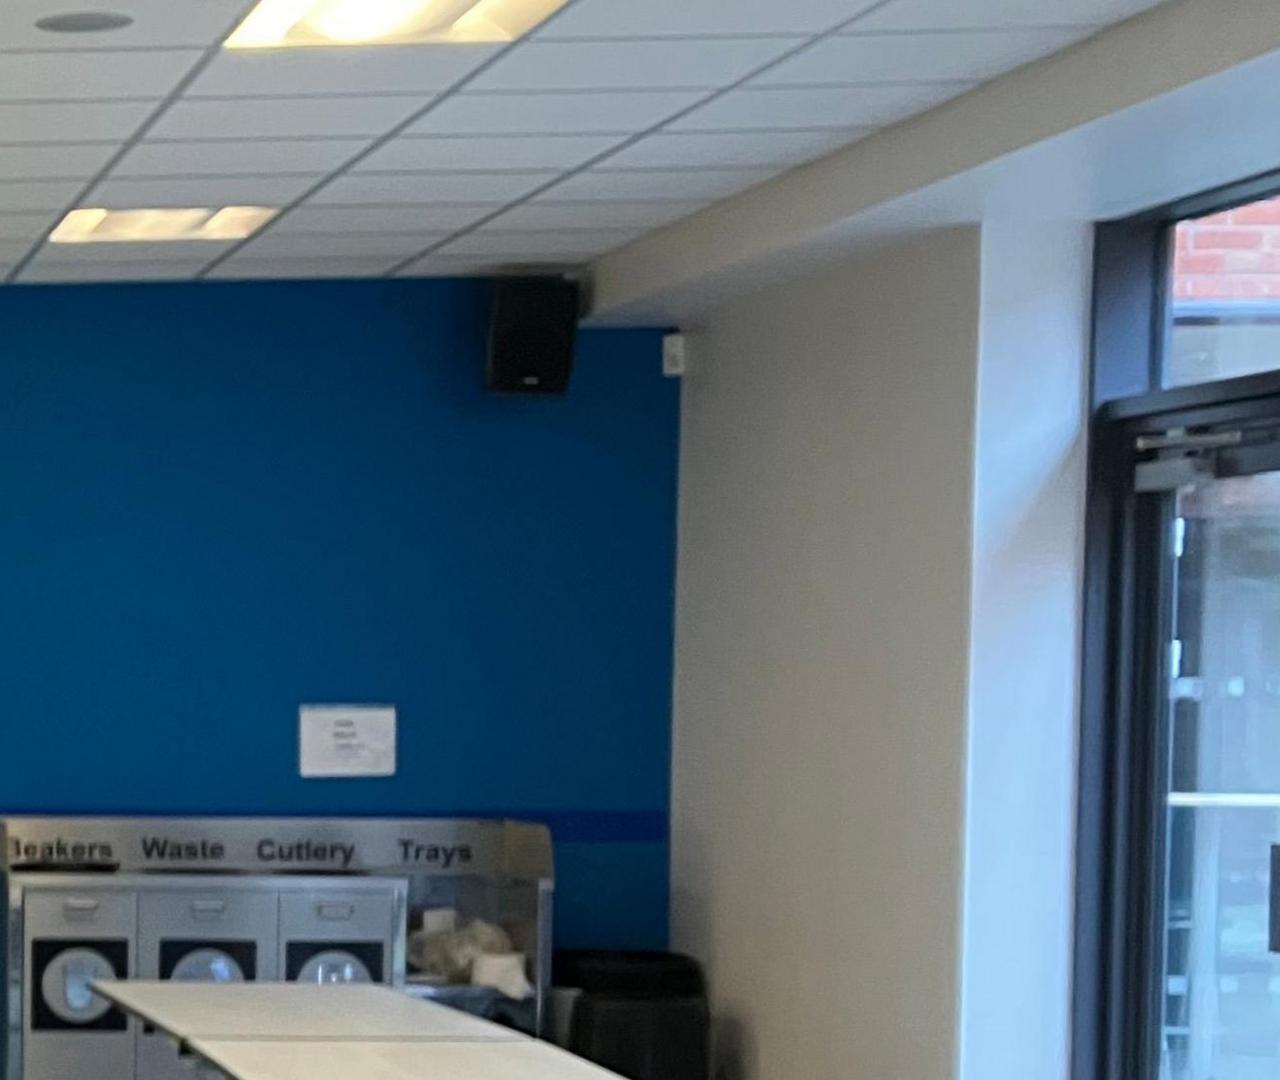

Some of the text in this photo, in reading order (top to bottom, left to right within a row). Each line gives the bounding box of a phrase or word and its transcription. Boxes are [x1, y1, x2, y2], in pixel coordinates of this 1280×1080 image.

[142, 837, 226, 860] Waste
[256, 838, 356, 868] Cutlery
[397, 838, 472, 868] Trays
